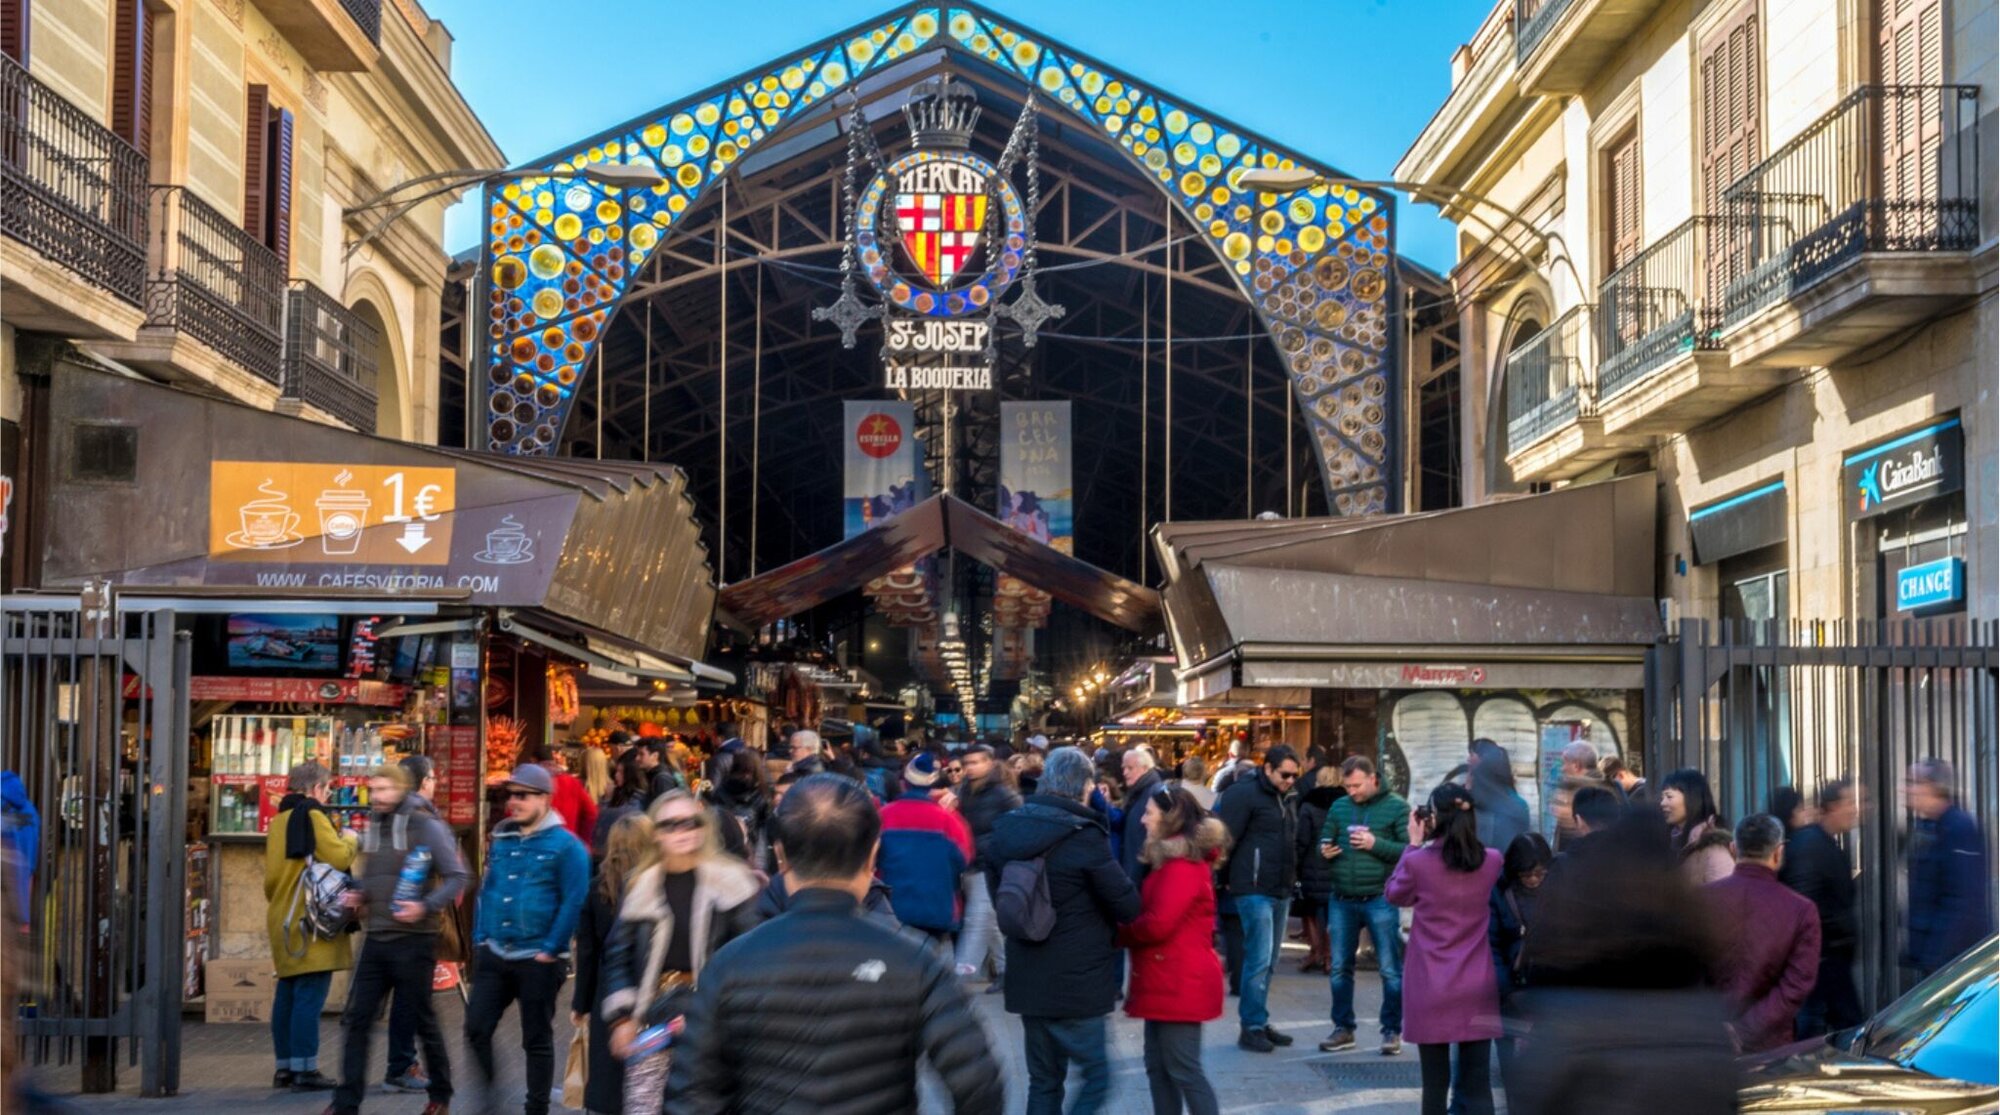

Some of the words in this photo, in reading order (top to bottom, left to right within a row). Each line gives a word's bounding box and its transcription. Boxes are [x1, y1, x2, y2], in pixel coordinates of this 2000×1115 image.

[898, 160, 986, 193] MERCAT
[911, 321, 989, 351] JOSEP
[885, 366, 907, 388] LA
[910, 366, 992, 389] BOQUERIA
[1881, 445, 1942, 491] CaixaBank
[256, 573, 307, 588] WWW
[457, 575, 499, 593] COM
[1900, 568, 1951, 600] CHANGE
[1401, 664, 1466, 682] Marcos
[265, 778, 286, 787] HOT
